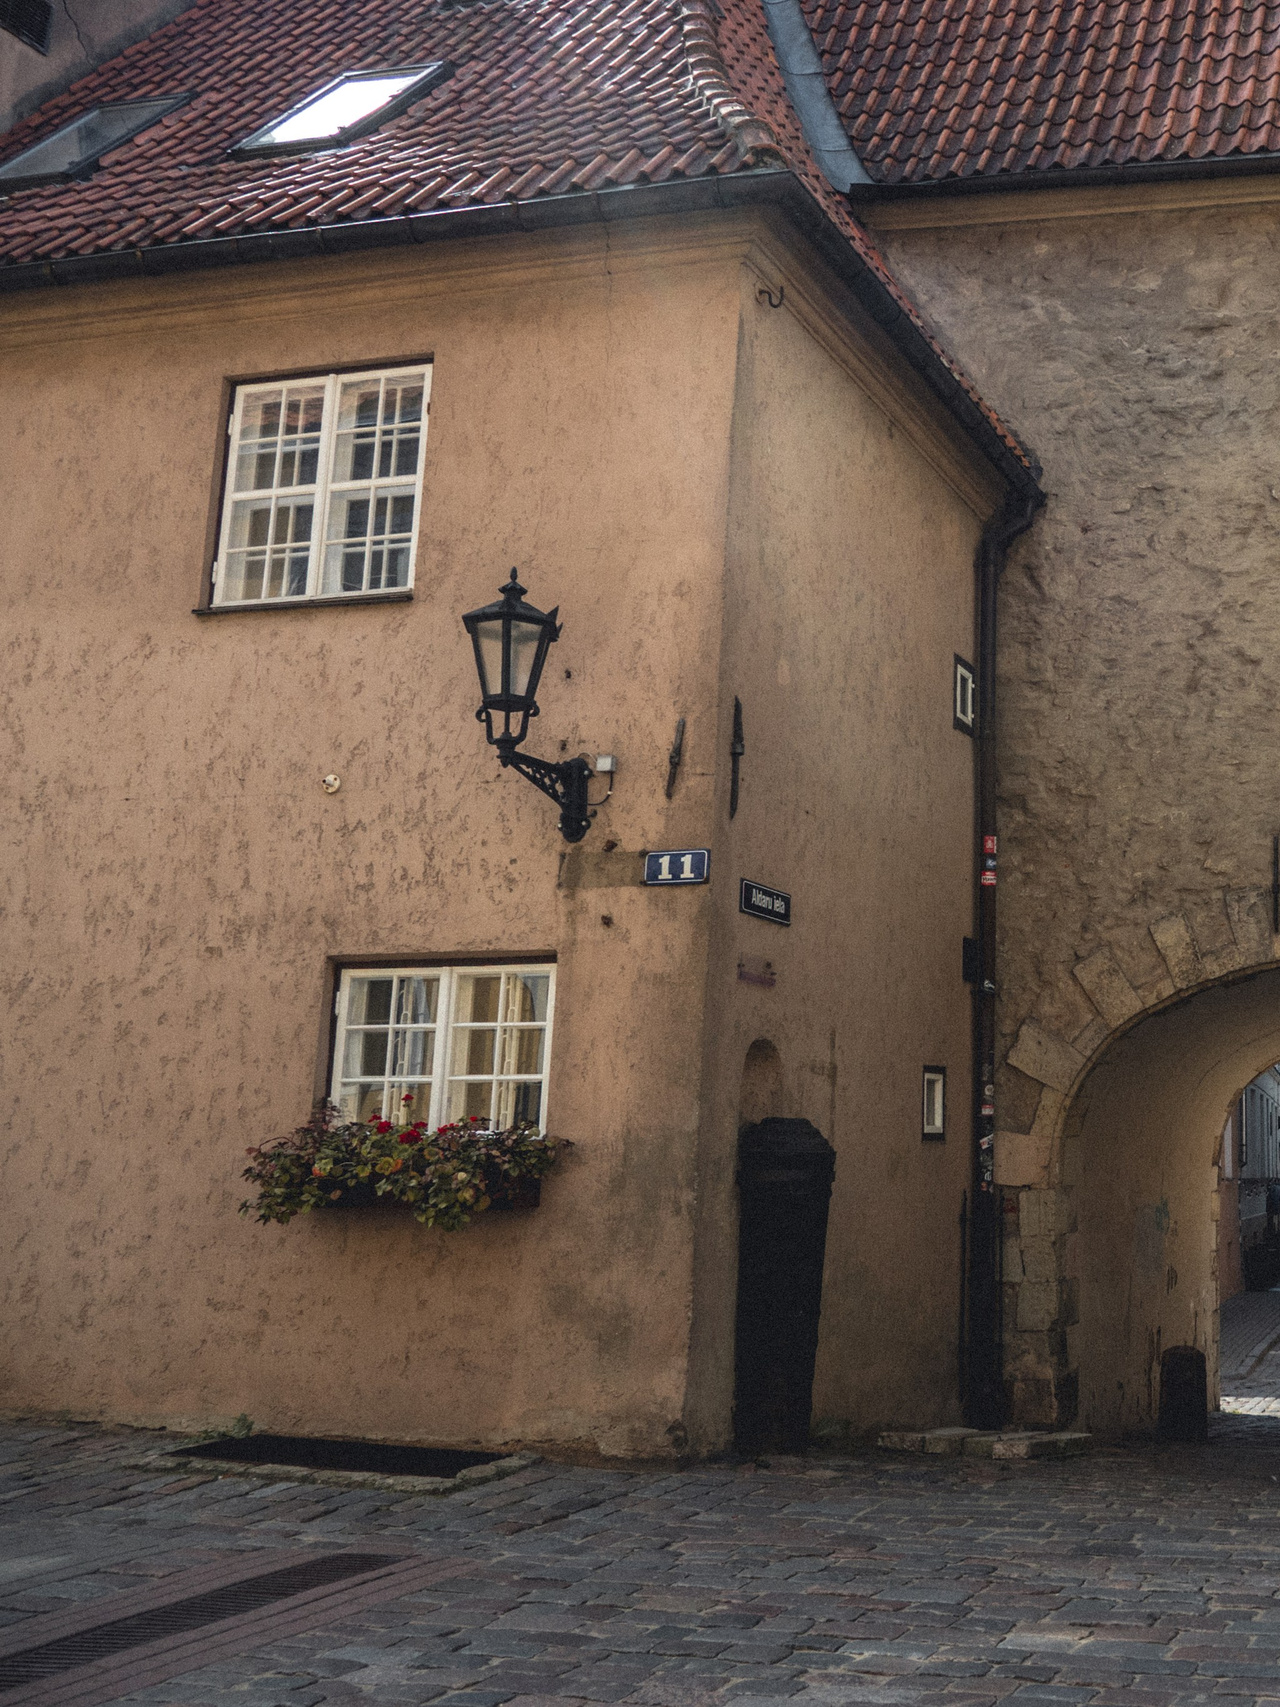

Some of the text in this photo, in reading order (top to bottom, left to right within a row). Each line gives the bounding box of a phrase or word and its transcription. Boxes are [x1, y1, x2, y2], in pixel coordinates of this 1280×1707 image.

[658, 854, 695, 880] 11
[751, 888, 786, 914] Aldaru iela
